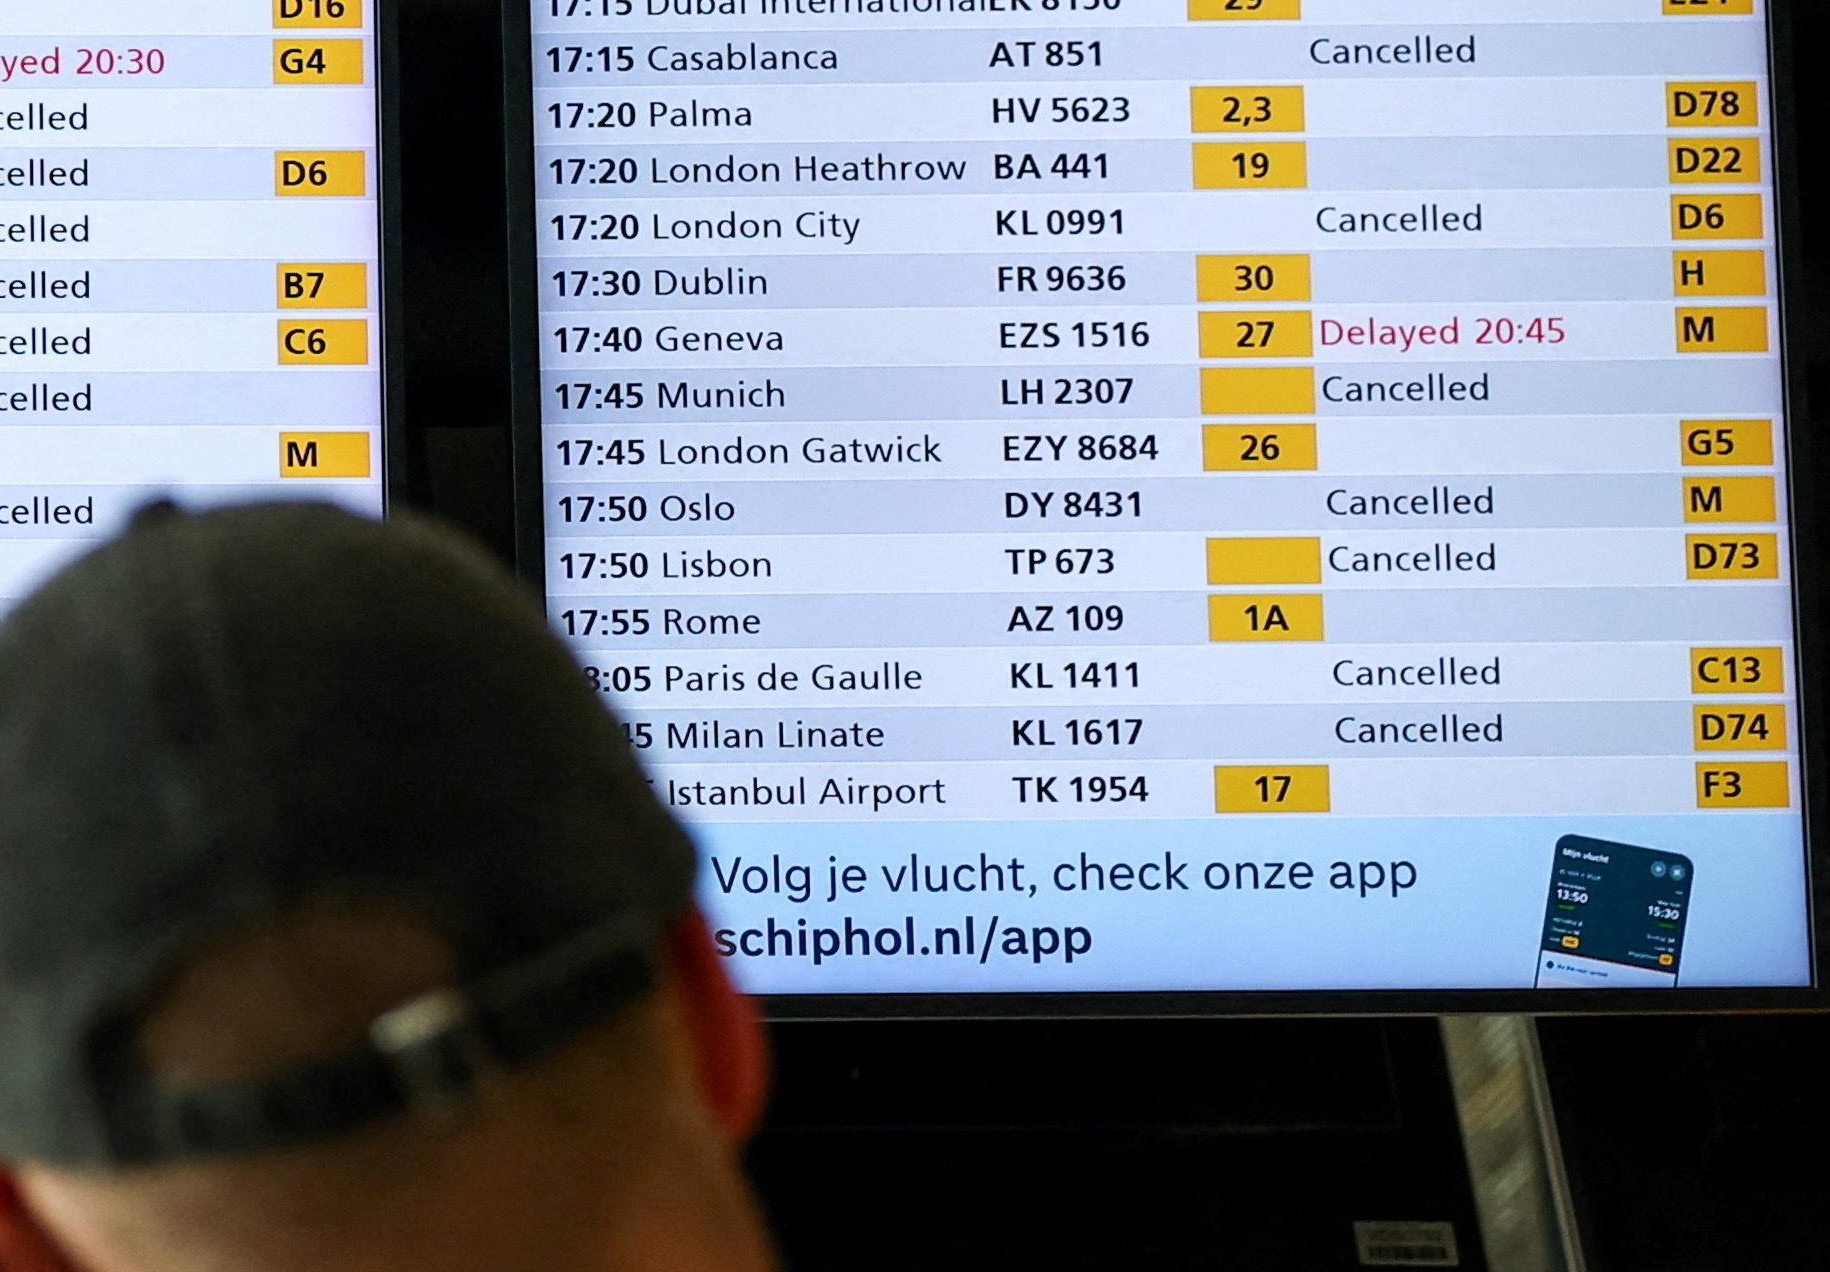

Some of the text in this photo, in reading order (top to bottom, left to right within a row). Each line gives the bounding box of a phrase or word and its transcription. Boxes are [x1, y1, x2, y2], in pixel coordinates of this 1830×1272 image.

[548, 145, 1744, 186] 17:20 London Heathrow BA 441 19 D22
[285, 440, 319, 469] M
[555, 427, 1736, 468] 17:45 London Gatwick EZY 8684 26 G5
[557, 484, 1724, 524] 17:50 Oslo DY 8431 Cancelled M
